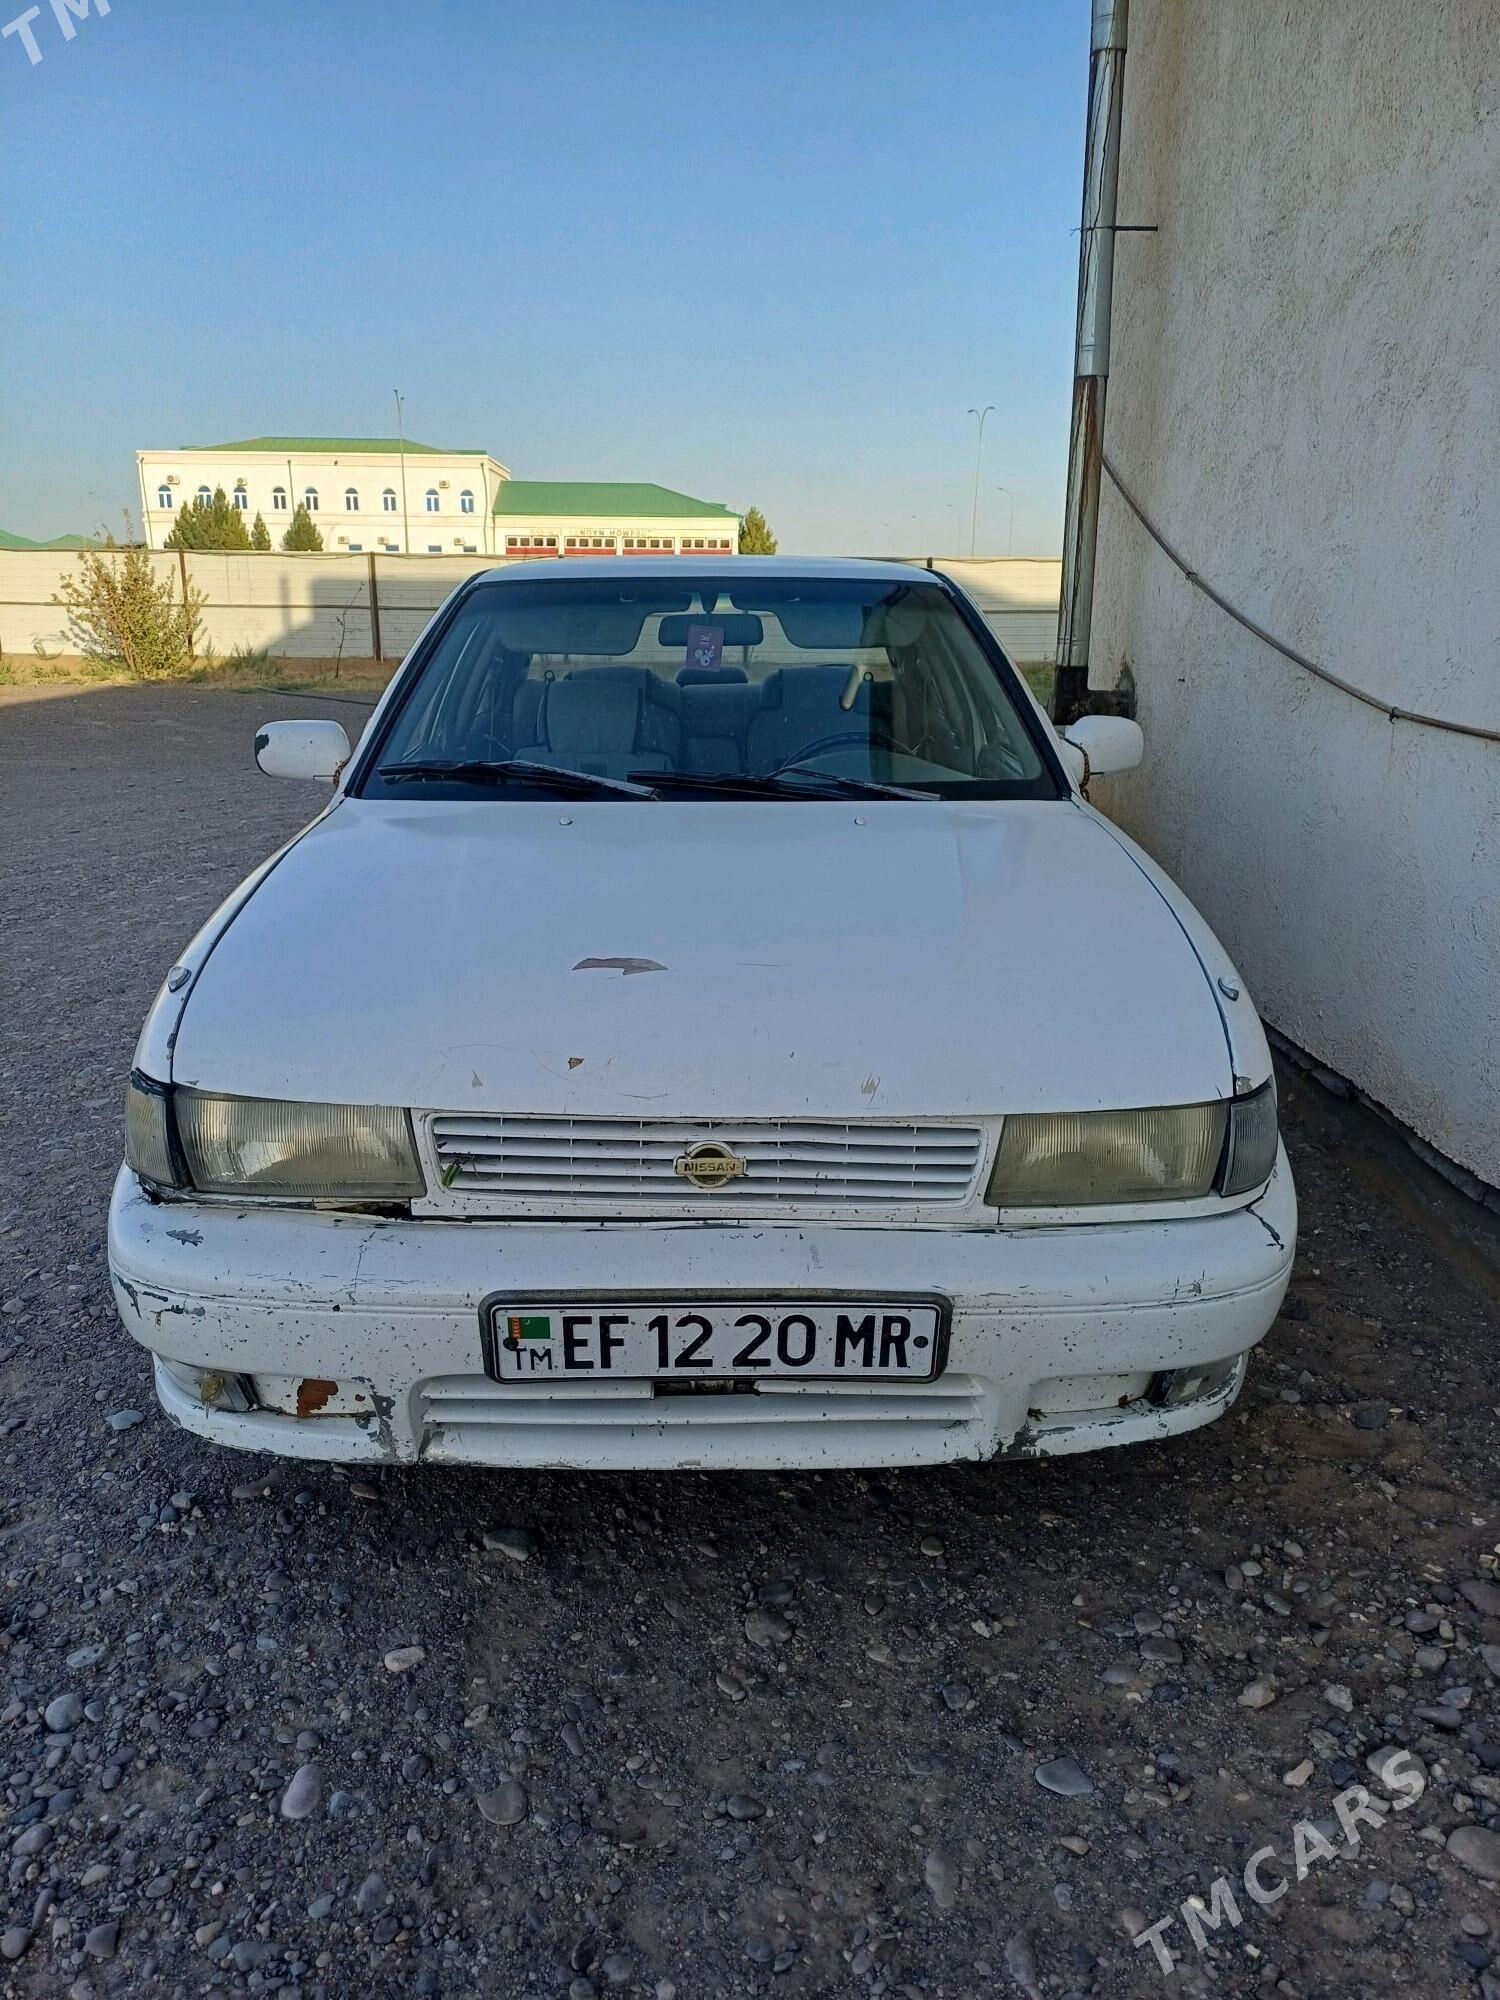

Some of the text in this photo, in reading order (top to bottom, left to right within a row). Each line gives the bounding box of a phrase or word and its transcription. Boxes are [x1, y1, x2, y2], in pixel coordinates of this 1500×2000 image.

[684, 1162, 736, 1172] NISSAN
[562, 1313, 912, 1370] EF 12 20 MR
[513, 1347, 554, 1371] TM
